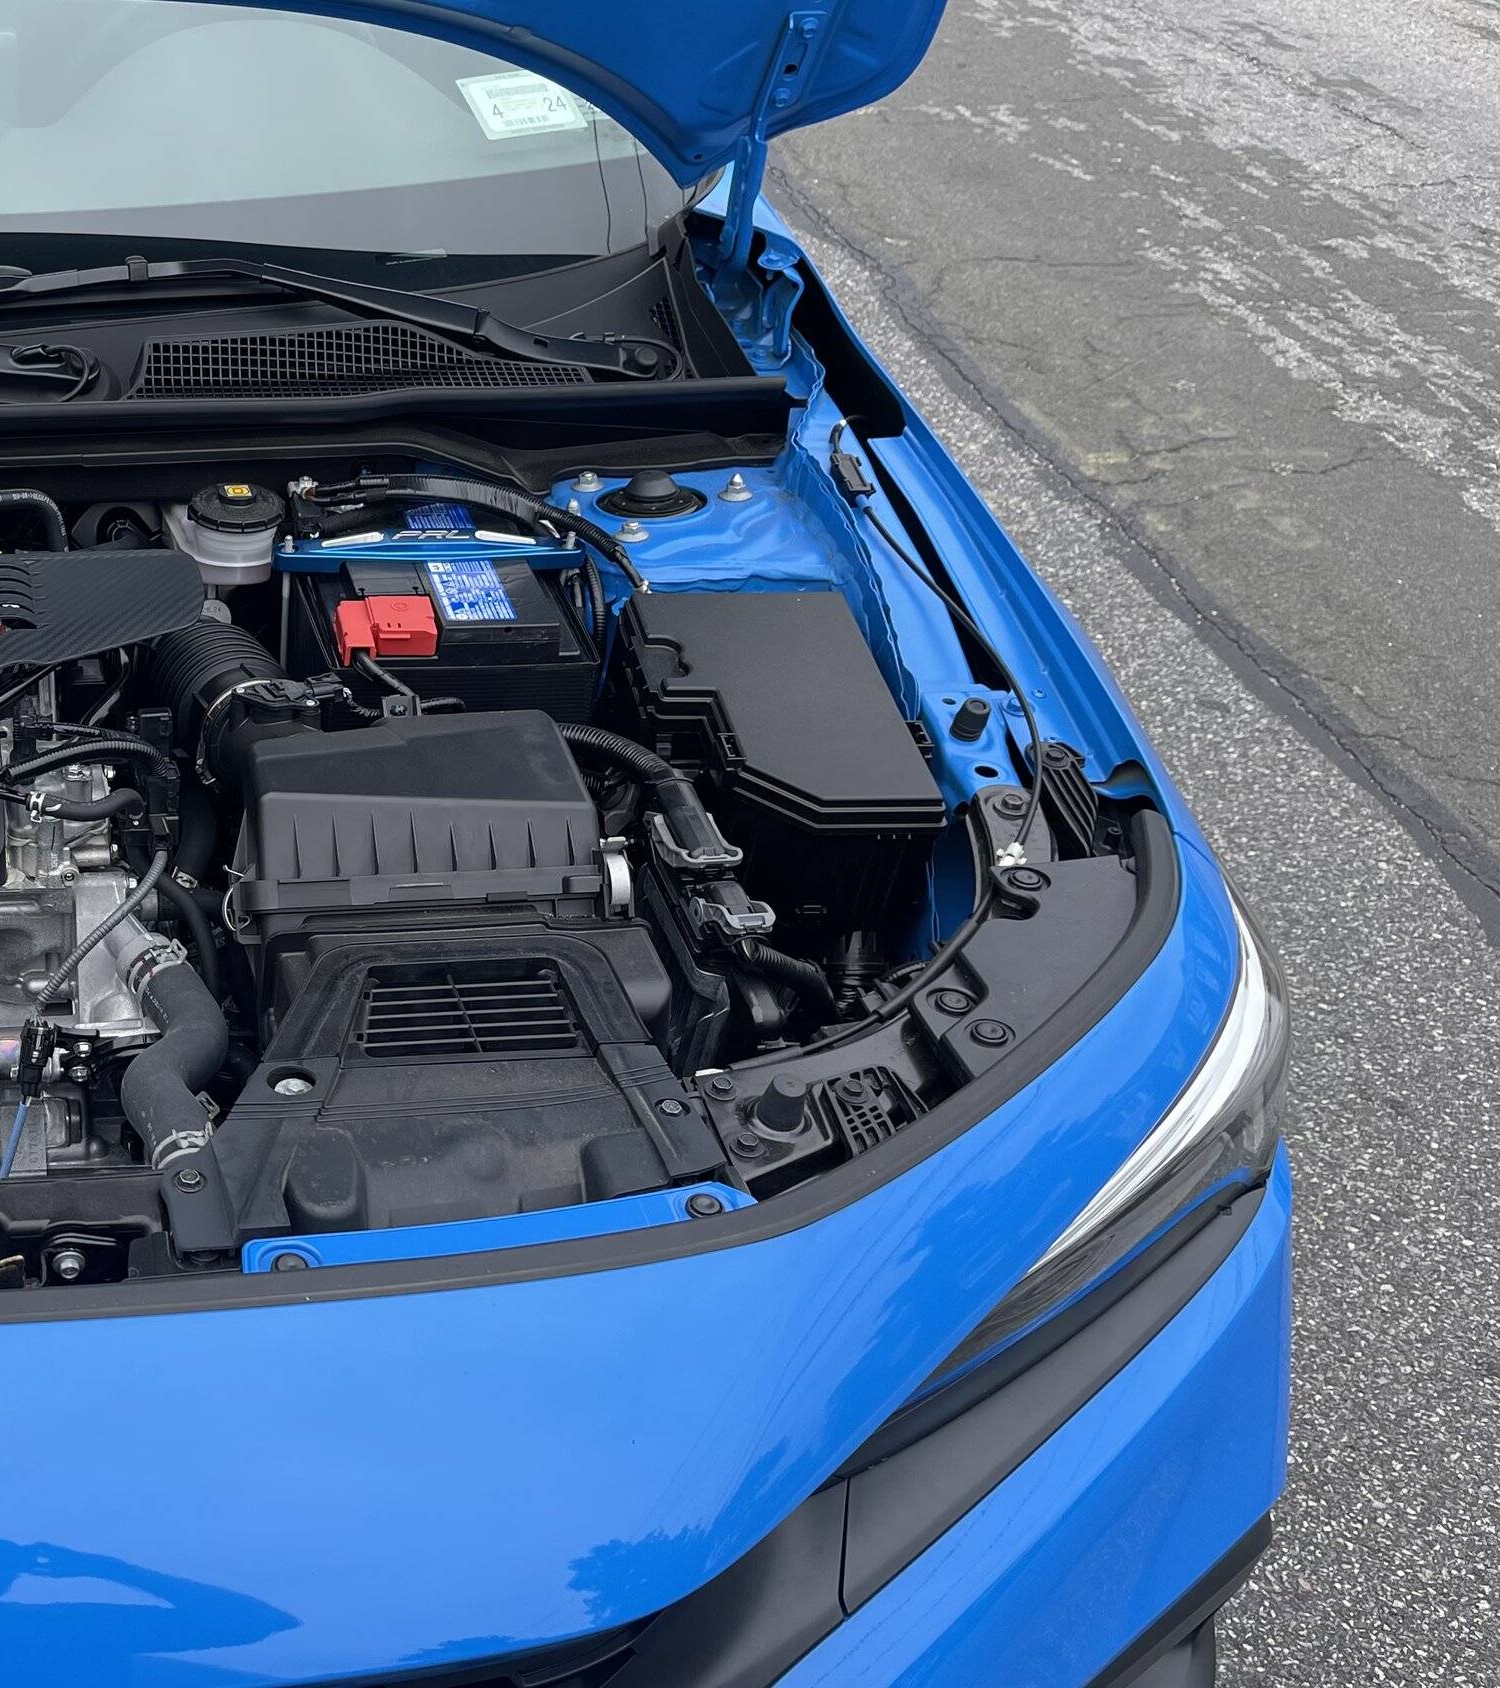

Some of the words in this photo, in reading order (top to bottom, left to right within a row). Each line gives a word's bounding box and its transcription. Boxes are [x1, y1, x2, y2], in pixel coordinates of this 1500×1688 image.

[492, 103, 504, 119] 4
[542, 95, 567, 112] 24
[391, 529, 470, 540] PRL
